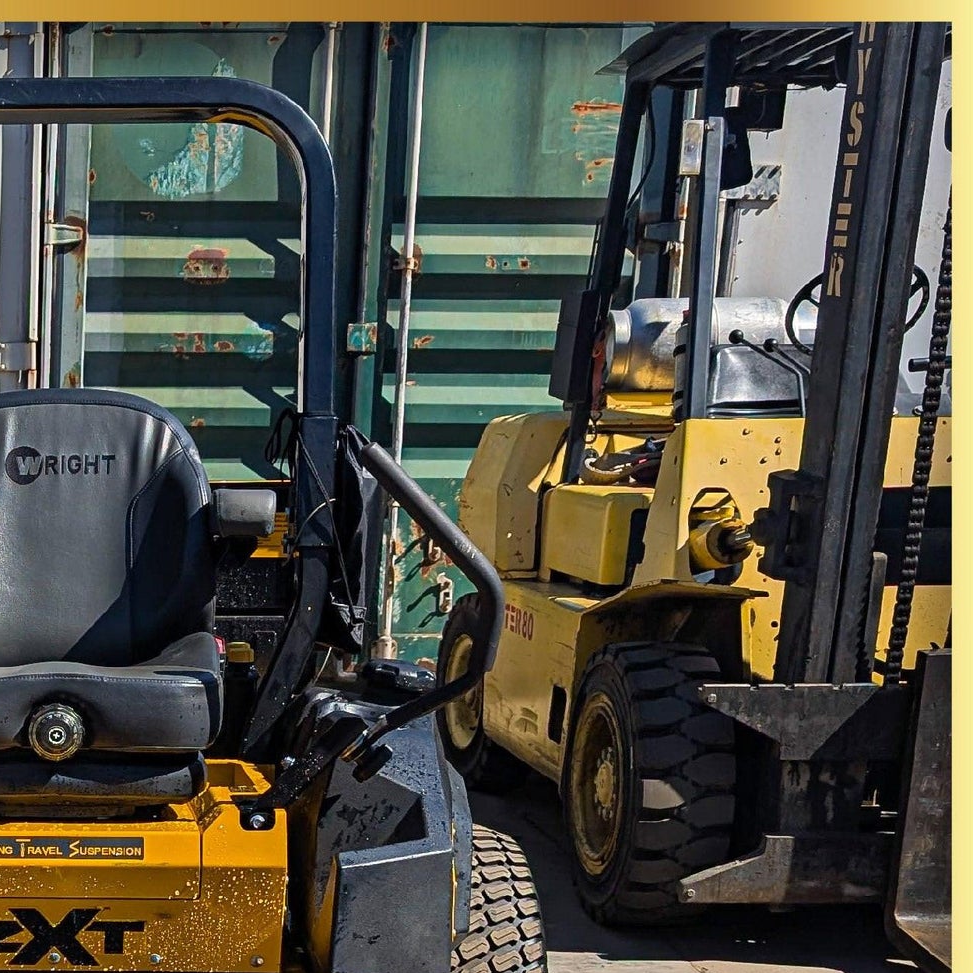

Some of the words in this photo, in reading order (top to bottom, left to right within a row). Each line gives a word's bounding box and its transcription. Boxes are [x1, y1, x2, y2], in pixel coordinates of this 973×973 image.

[12, 451, 116, 478] WRIGHT
[15, 838, 63, 857] TRAVEL
[69, 839, 142, 858] SUSPENSION
